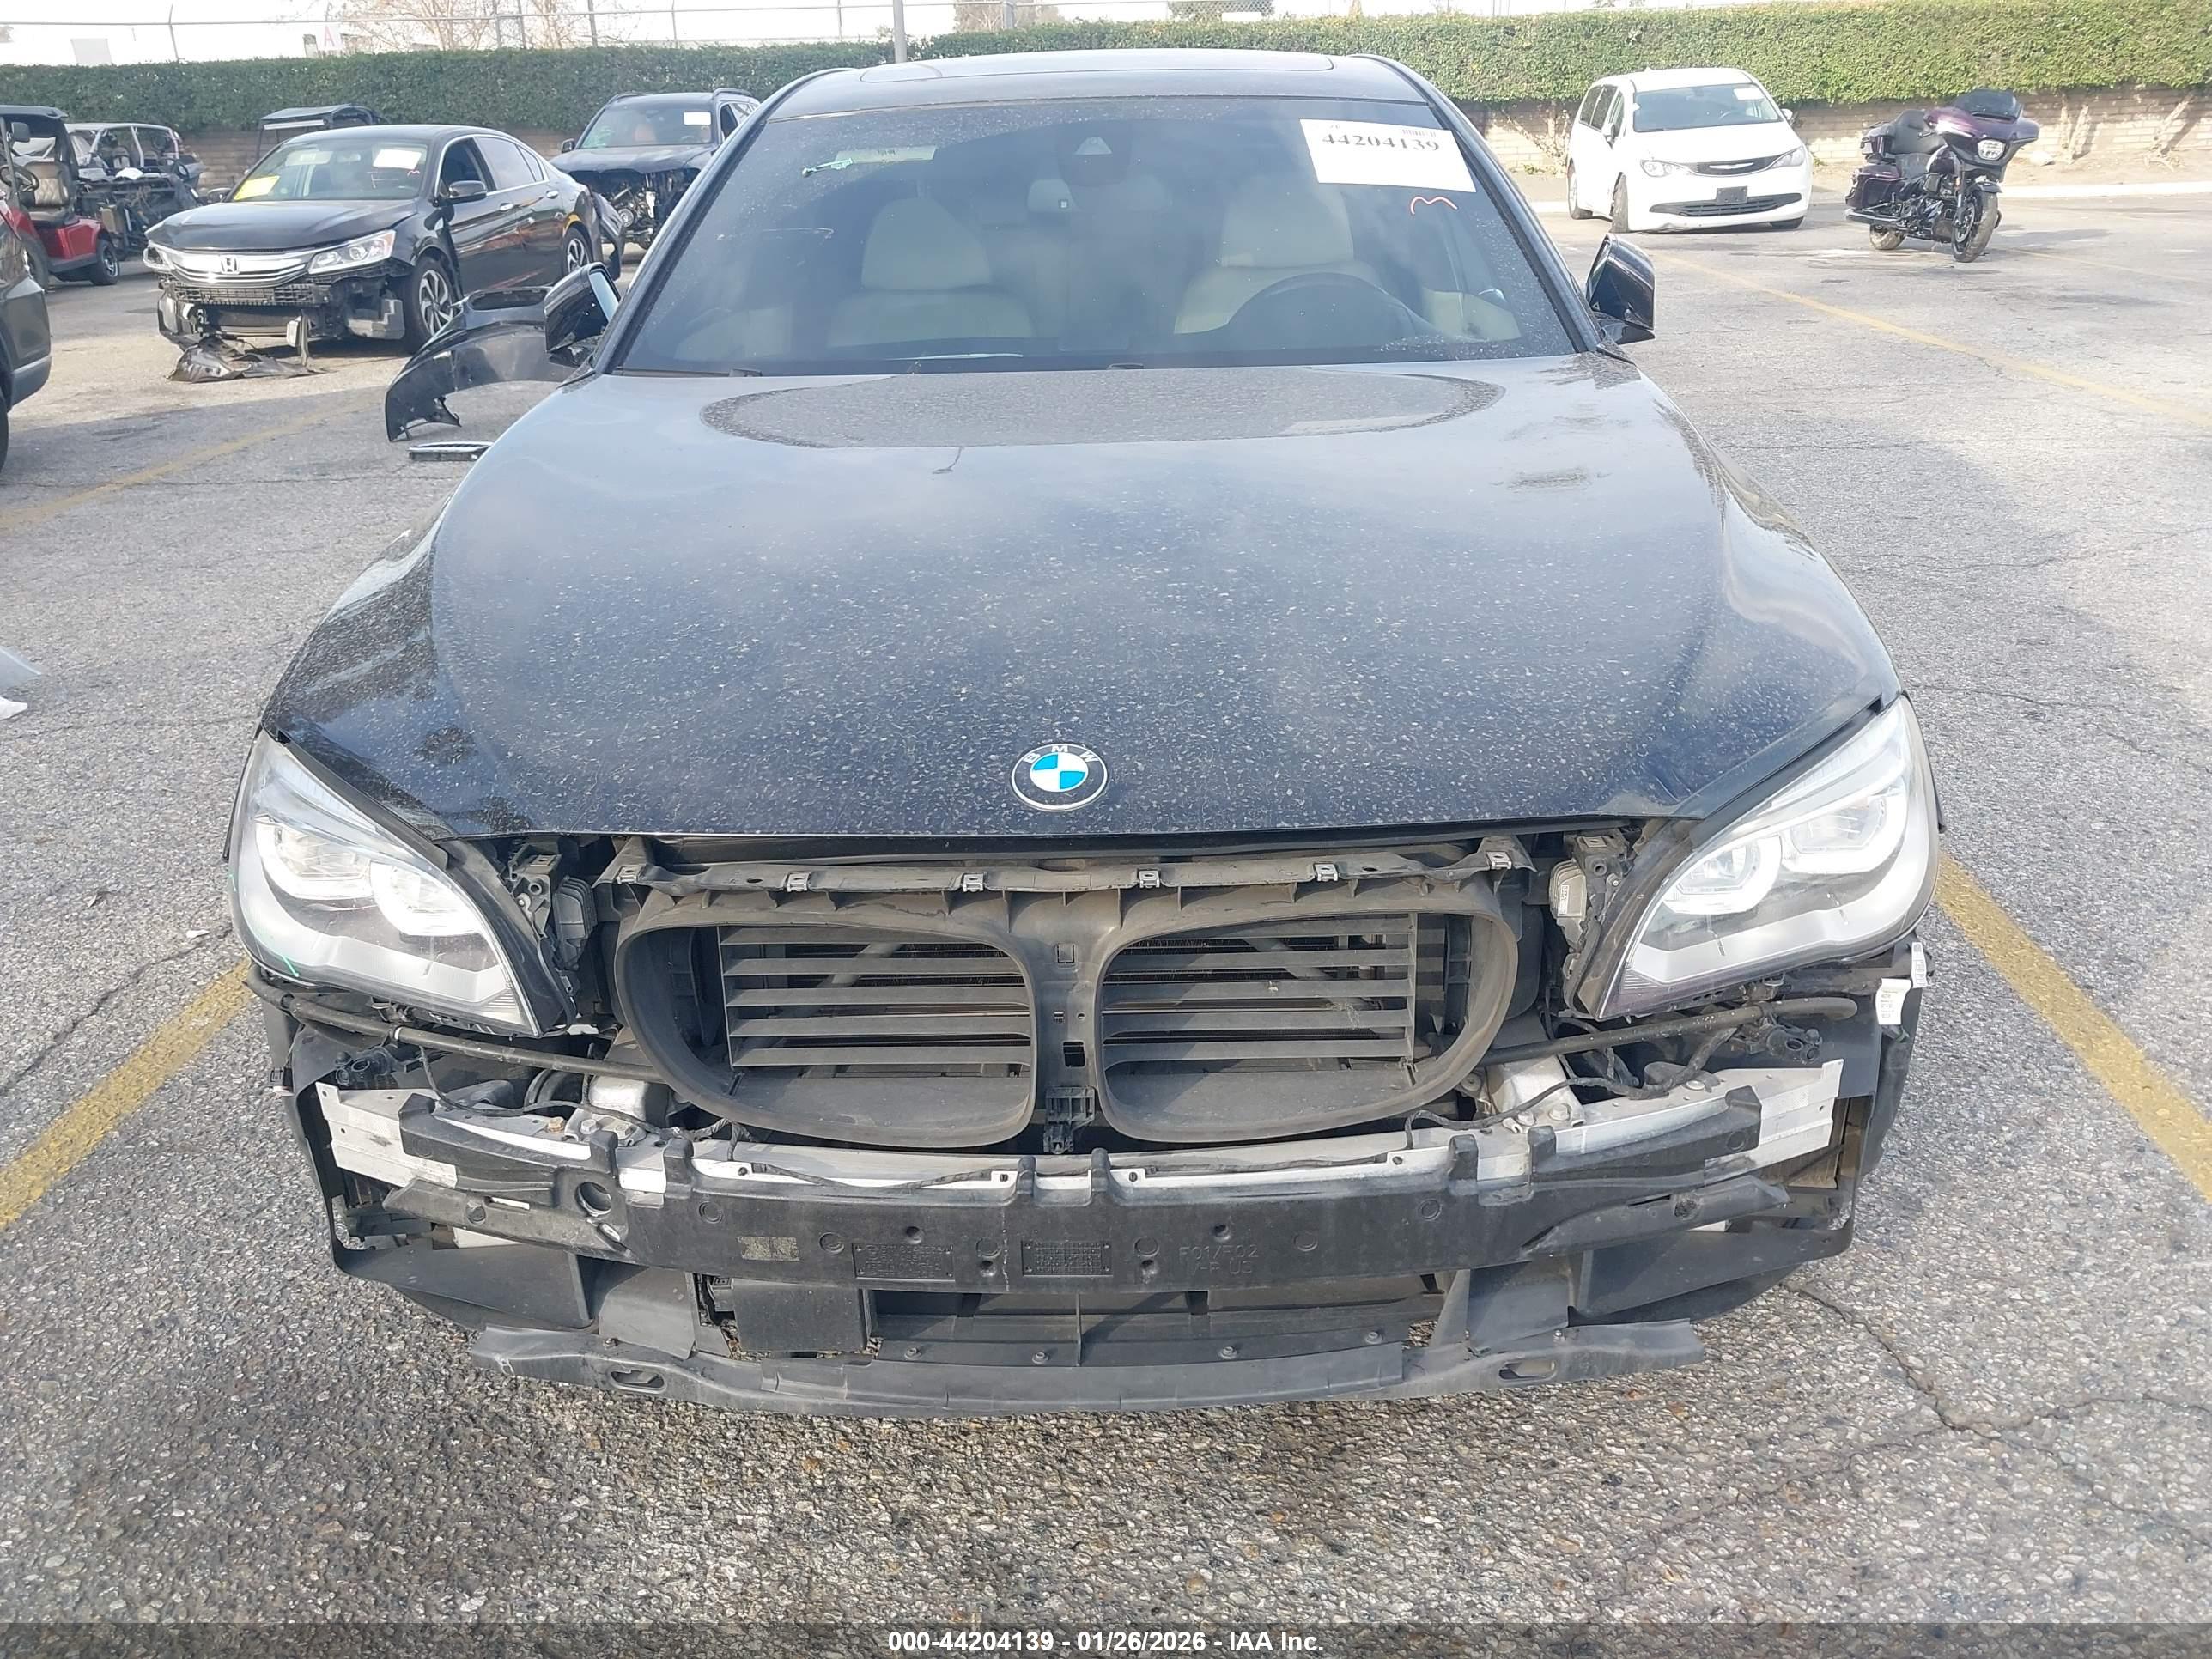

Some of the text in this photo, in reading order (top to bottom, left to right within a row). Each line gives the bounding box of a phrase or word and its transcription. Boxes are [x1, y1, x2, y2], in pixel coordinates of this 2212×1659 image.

[323, 25, 336, 47] A
[1322, 132, 1440, 151] 44204139
[1022, 744, 1100, 763] BMW
